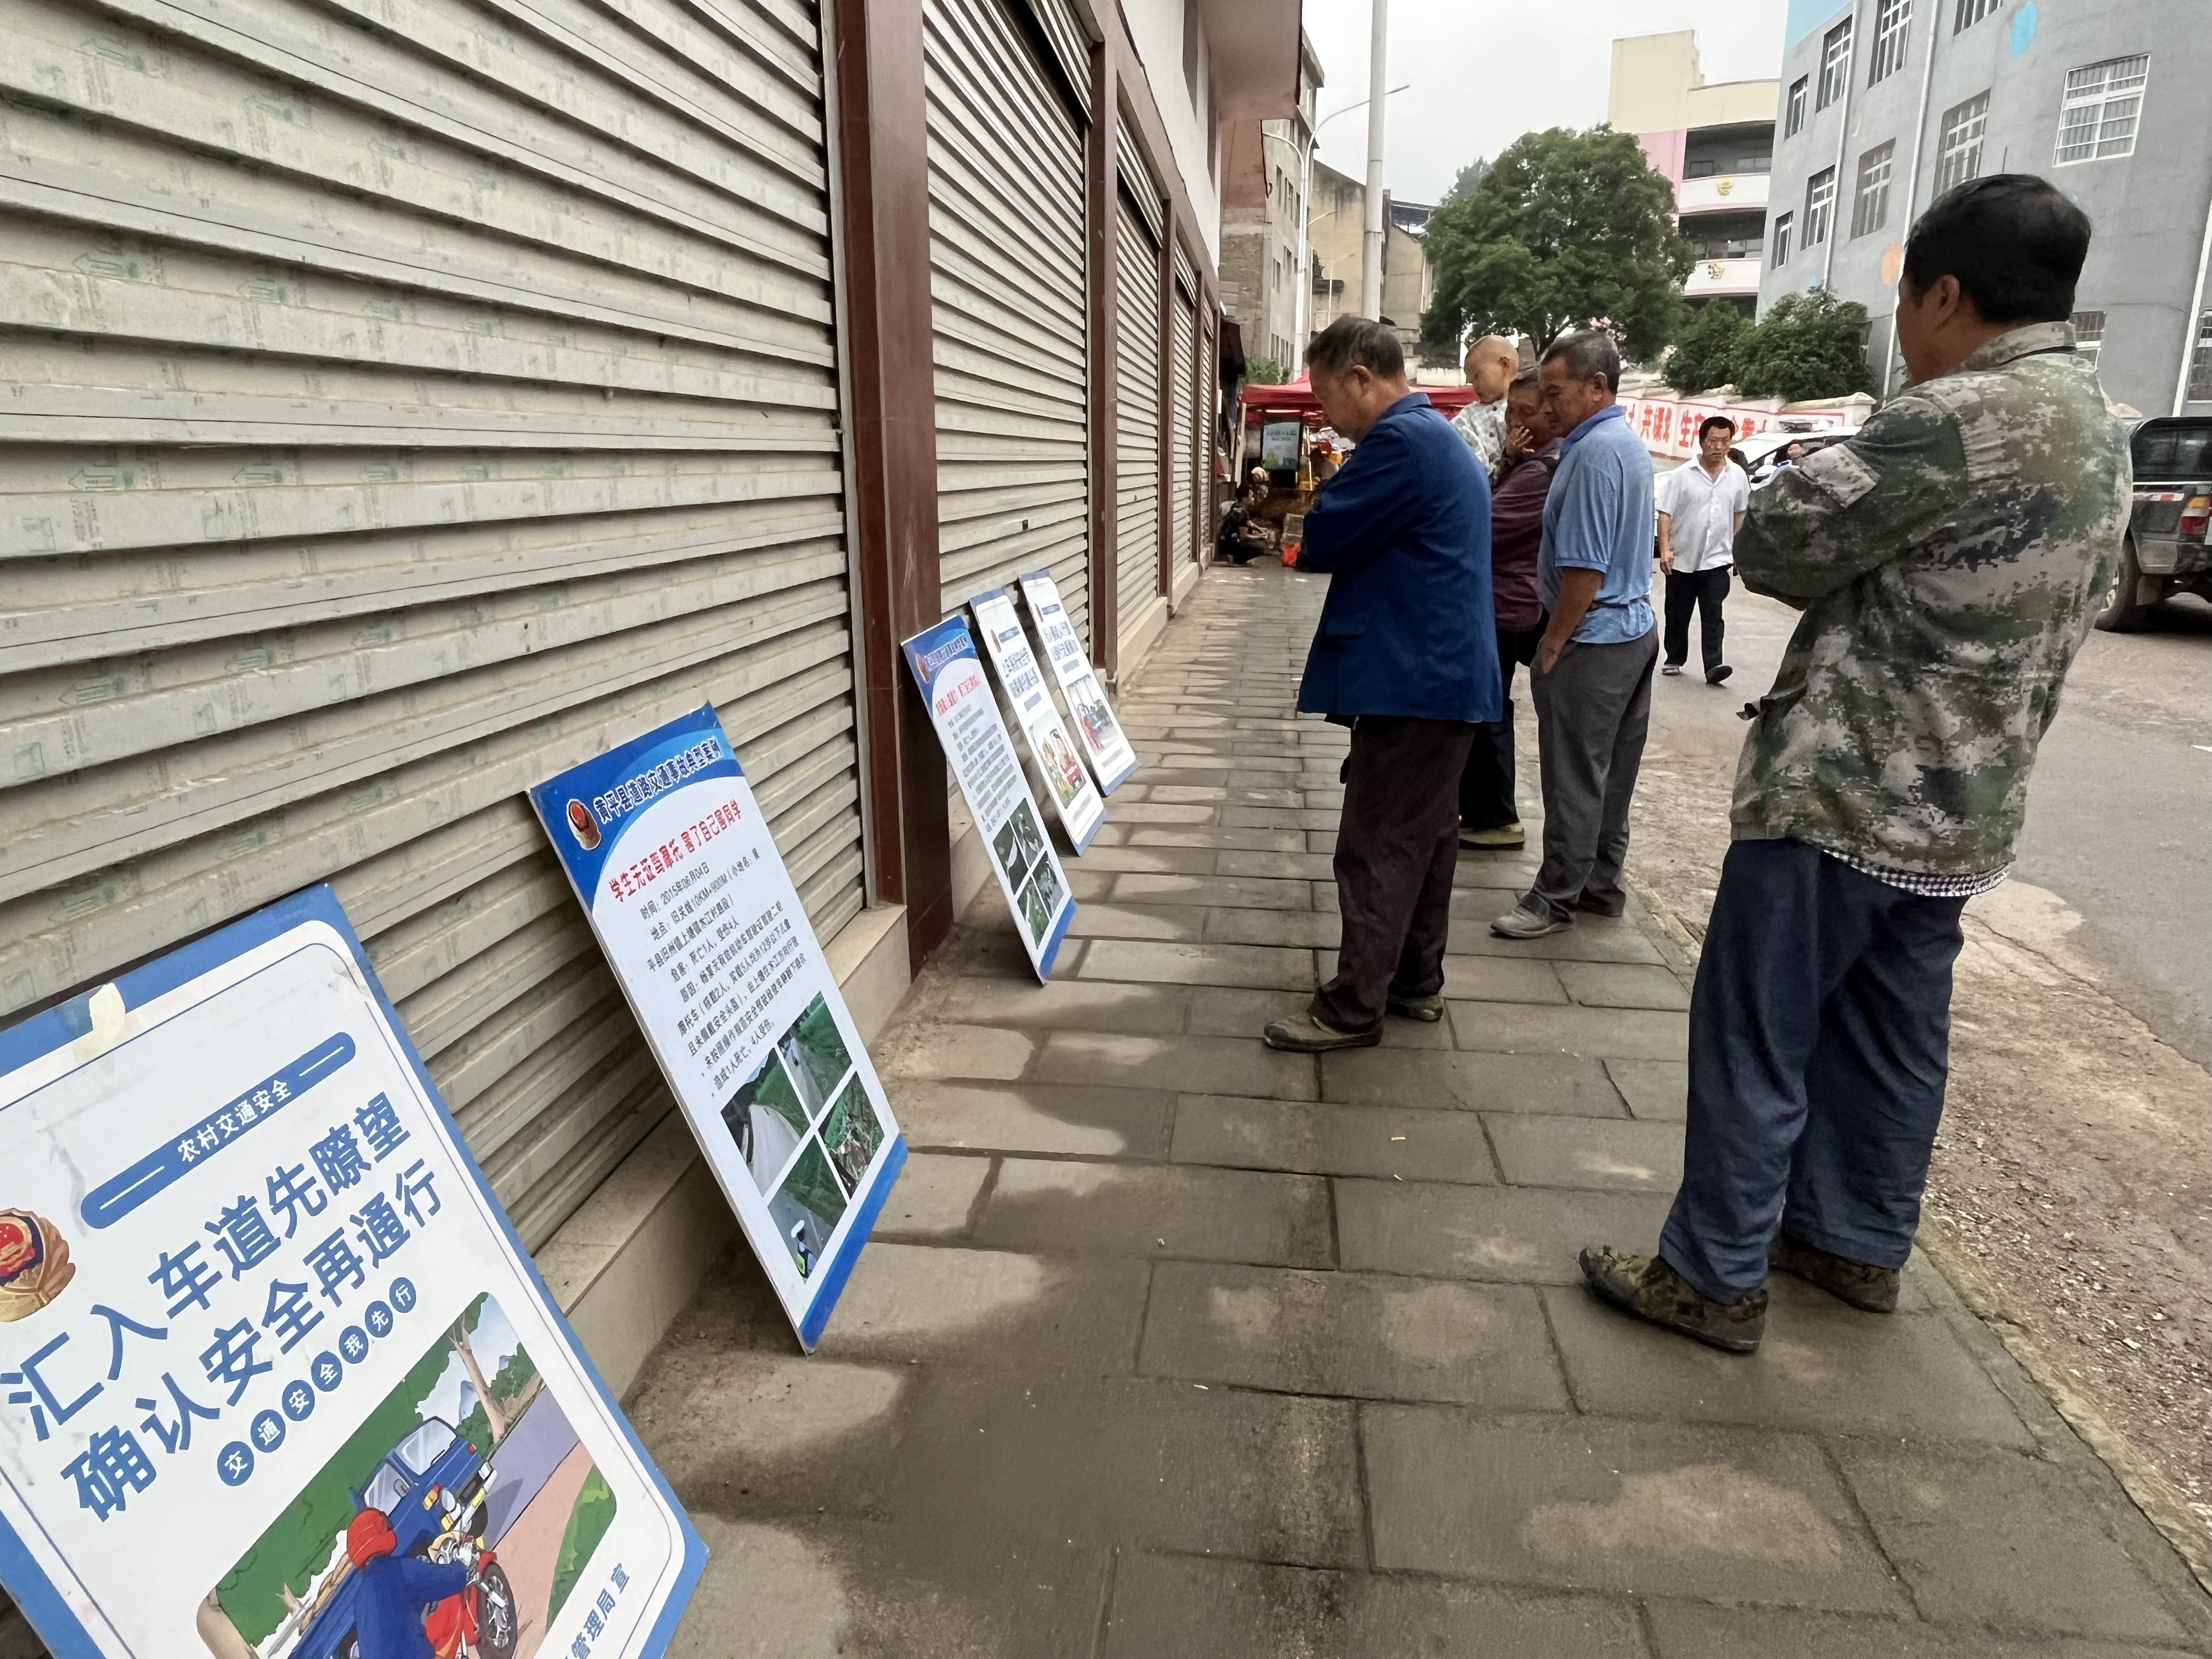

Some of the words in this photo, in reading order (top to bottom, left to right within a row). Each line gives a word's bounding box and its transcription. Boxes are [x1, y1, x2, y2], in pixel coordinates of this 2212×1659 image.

[177, 1079, 292, 1163] 农村交通安全
[0, 1092, 411, 1441] 汇入车道先瞭望
[60, 1158, 441, 1522] 确认安全再通行
[224, 1283, 413, 1480] 交通安全我先行
[565, 1588, 616, 1659] 管理局
[611, 1562, 630, 1594] 宣
